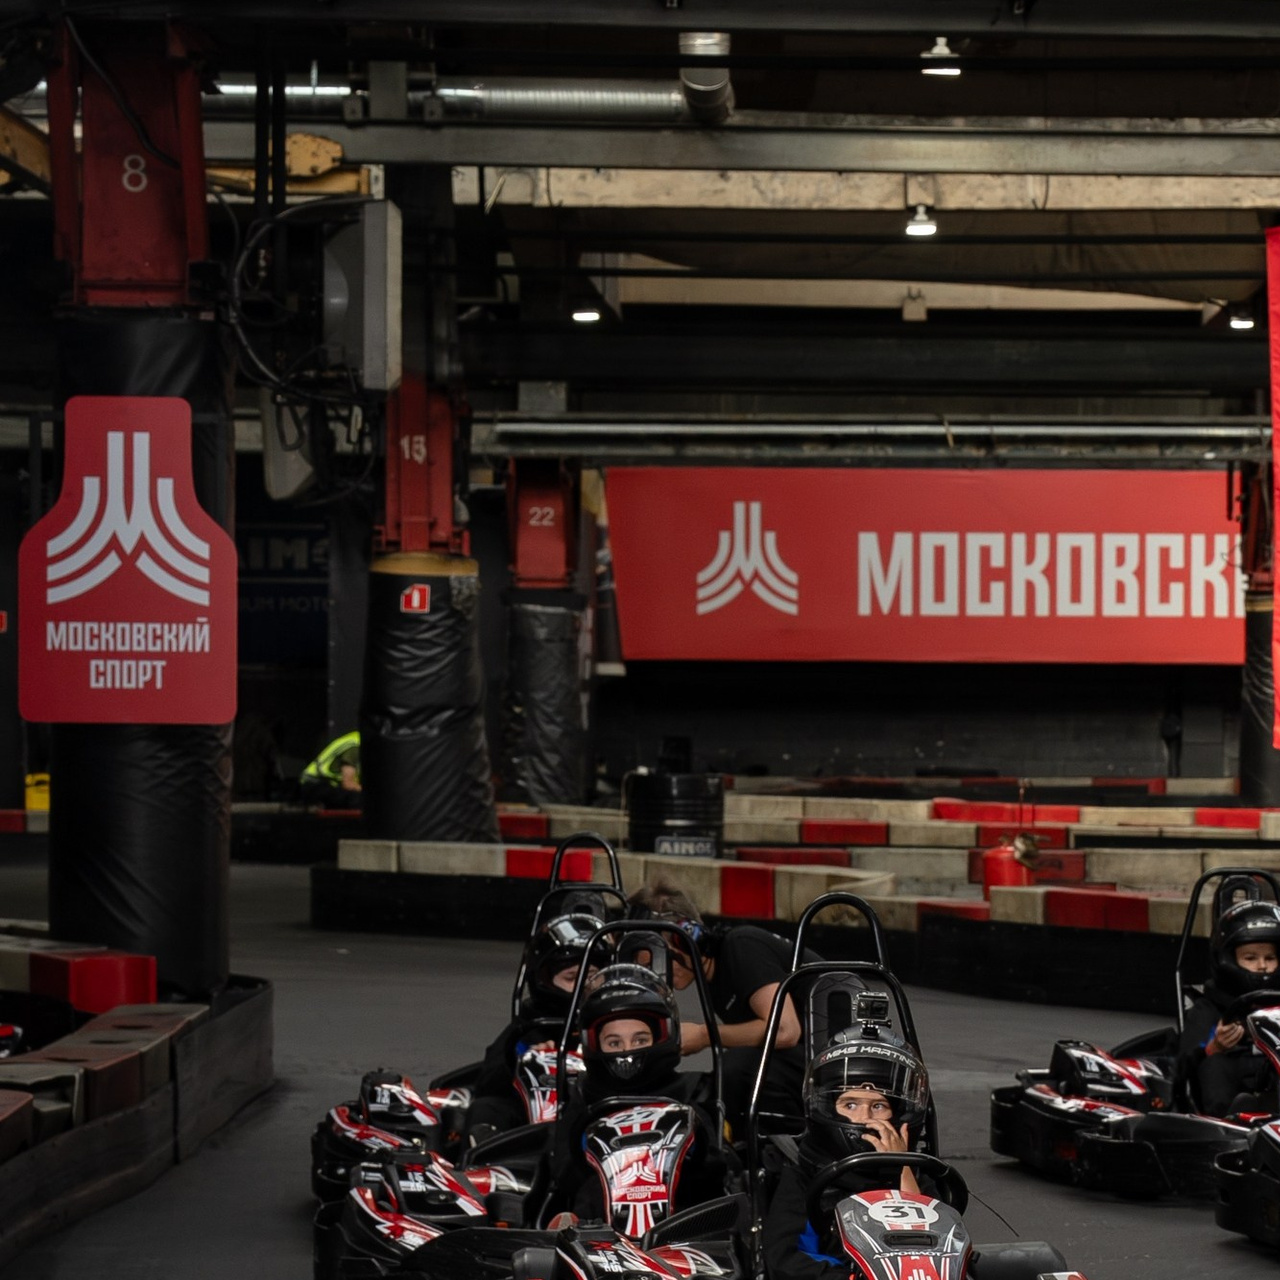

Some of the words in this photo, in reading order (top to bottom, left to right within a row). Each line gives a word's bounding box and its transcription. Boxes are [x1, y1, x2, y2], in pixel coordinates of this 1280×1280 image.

[121, 154, 148, 193] 8
[528, 507, 555, 526] 22
[46, 617, 210, 652] МОСКОВСКИЙ
[89, 660, 166, 689] СПОРТ
[860, 1046, 917, 1069] KARTING
[881, 1206, 927, 1220] 31
